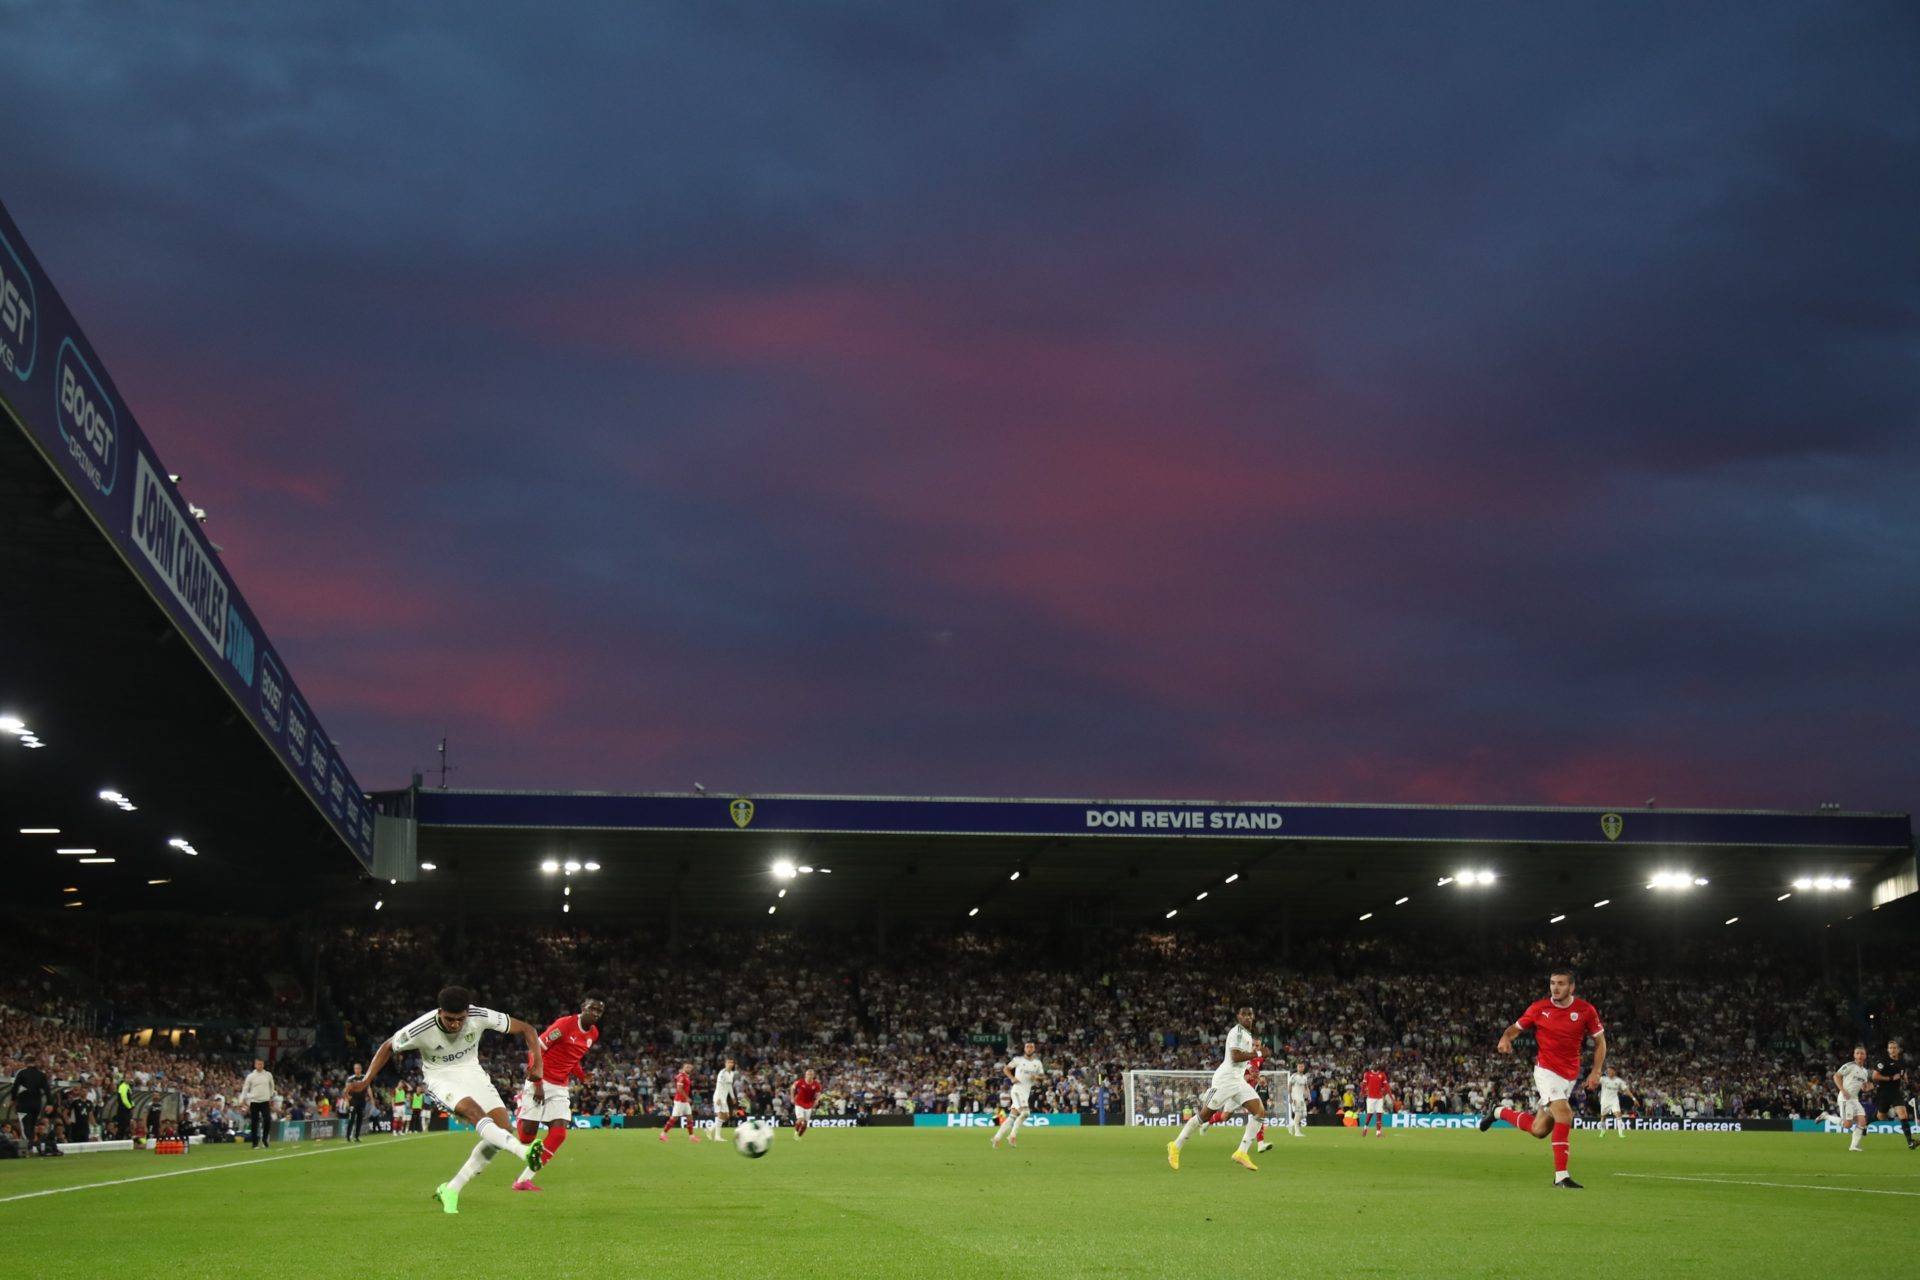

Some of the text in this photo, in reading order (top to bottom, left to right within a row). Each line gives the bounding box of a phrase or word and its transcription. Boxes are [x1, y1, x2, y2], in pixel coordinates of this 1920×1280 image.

[62, 363, 113, 465] BOOST
[68, 435, 101, 491] DRINKS
[137, 471, 255, 688] JOHN CHARLES STAND
[1086, 811, 1282, 829] DON REVIE STAND
[807, 1118, 857, 1128] reezers
[1135, 1114, 1180, 1127] PureFl
[1635, 1118, 1679, 1130] Fridge
[1683, 1119, 1742, 1131] Freezers
